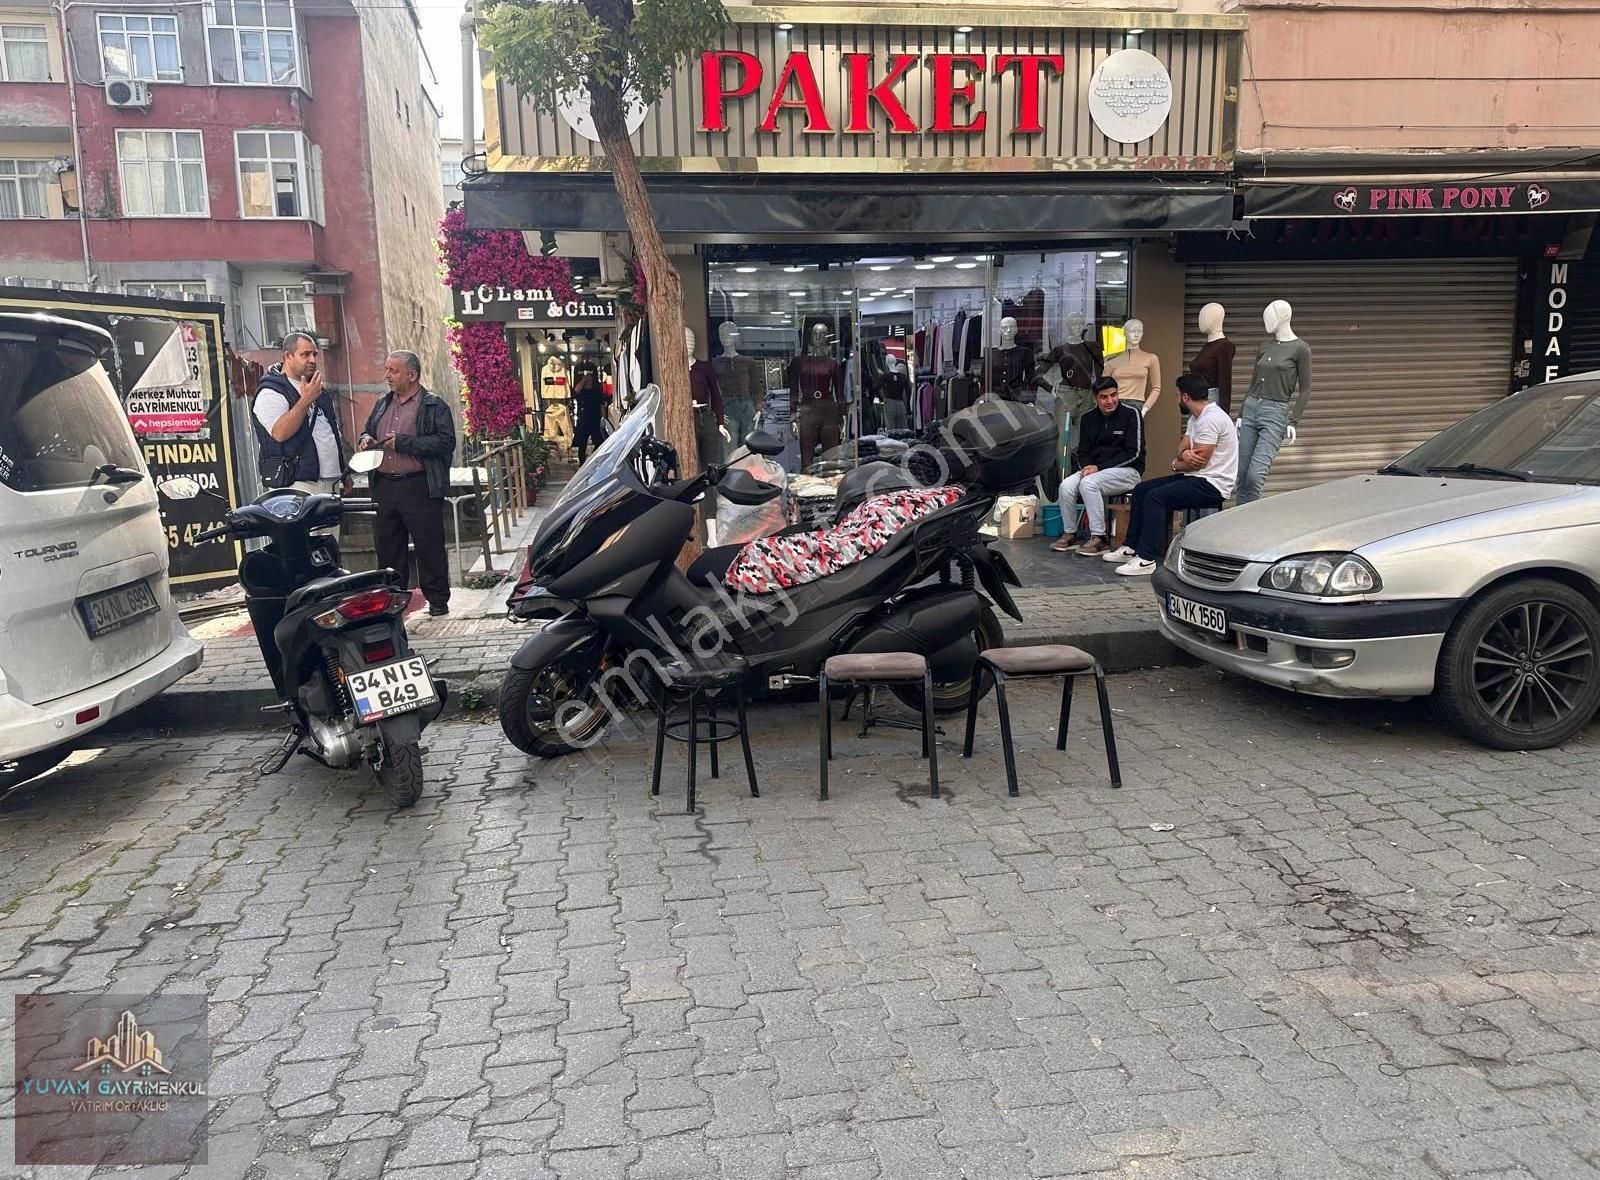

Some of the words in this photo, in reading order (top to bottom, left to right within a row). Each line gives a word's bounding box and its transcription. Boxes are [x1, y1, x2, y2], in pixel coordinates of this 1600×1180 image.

[696, 49, 1065, 134] PAKET
[1368, 188, 1434, 210] PINK
[1442, 187, 1515, 209] PONY
[1544, 263, 1568, 356] MODA
[129, 388, 165, 399] Merkez
[166, 388, 201, 399] Muhtar
[129, 398, 203, 413] GAYRİMENKUL
[148, 418, 204, 429] hepsiemlak
[13, 541, 77, 558] TOURNEO
[92, 597, 110, 626] 34
[110, 594, 130, 618] NL
[127, 582, 155, 611] 6991
[1170, 596, 1181, 617] 34
[1181, 599, 1197, 623] YK
[1199, 606, 1224, 630] 1560
[352, 672, 381, 693] 34
[382, 660, 424, 685] NIS
[377, 683, 419, 708] 849
